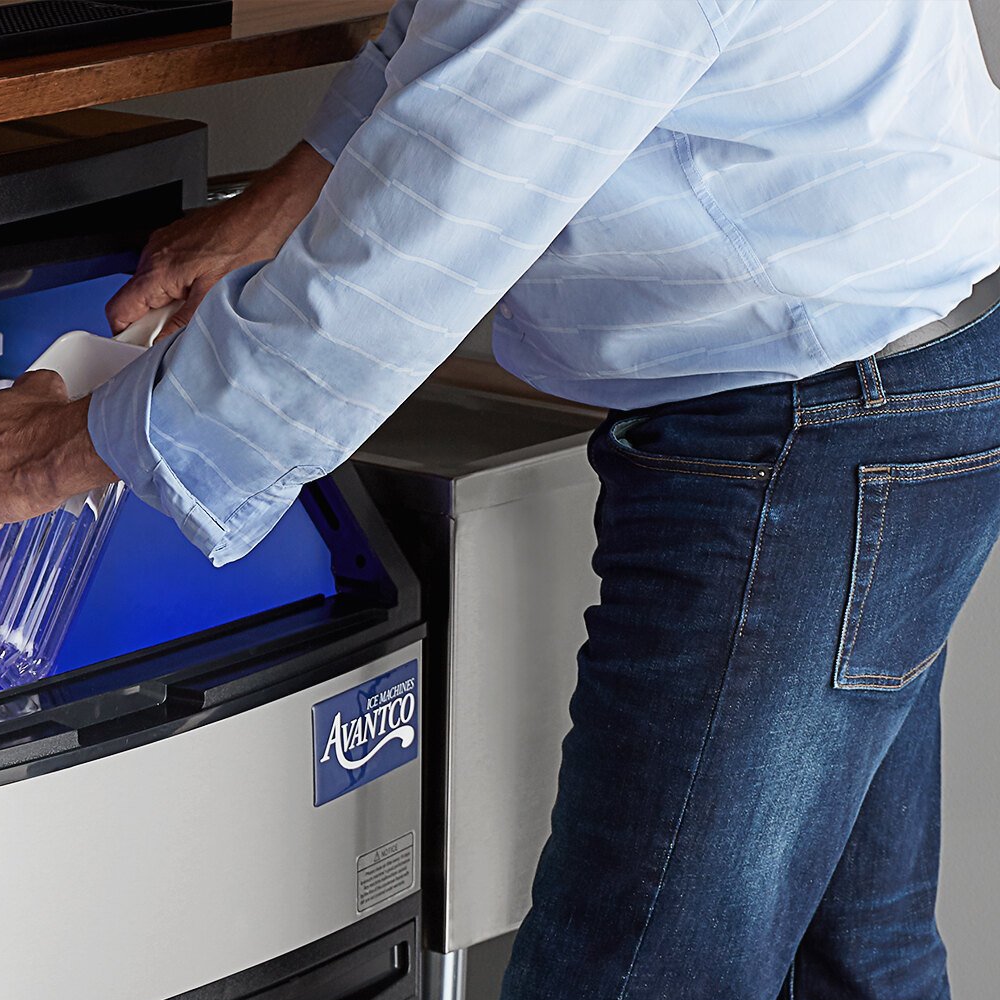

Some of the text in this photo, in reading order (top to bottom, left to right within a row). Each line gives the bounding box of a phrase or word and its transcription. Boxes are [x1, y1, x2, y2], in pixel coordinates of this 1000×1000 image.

[367, 679, 415, 710] ICE MACHINES
[320, 692, 415, 770] AVANTCO
